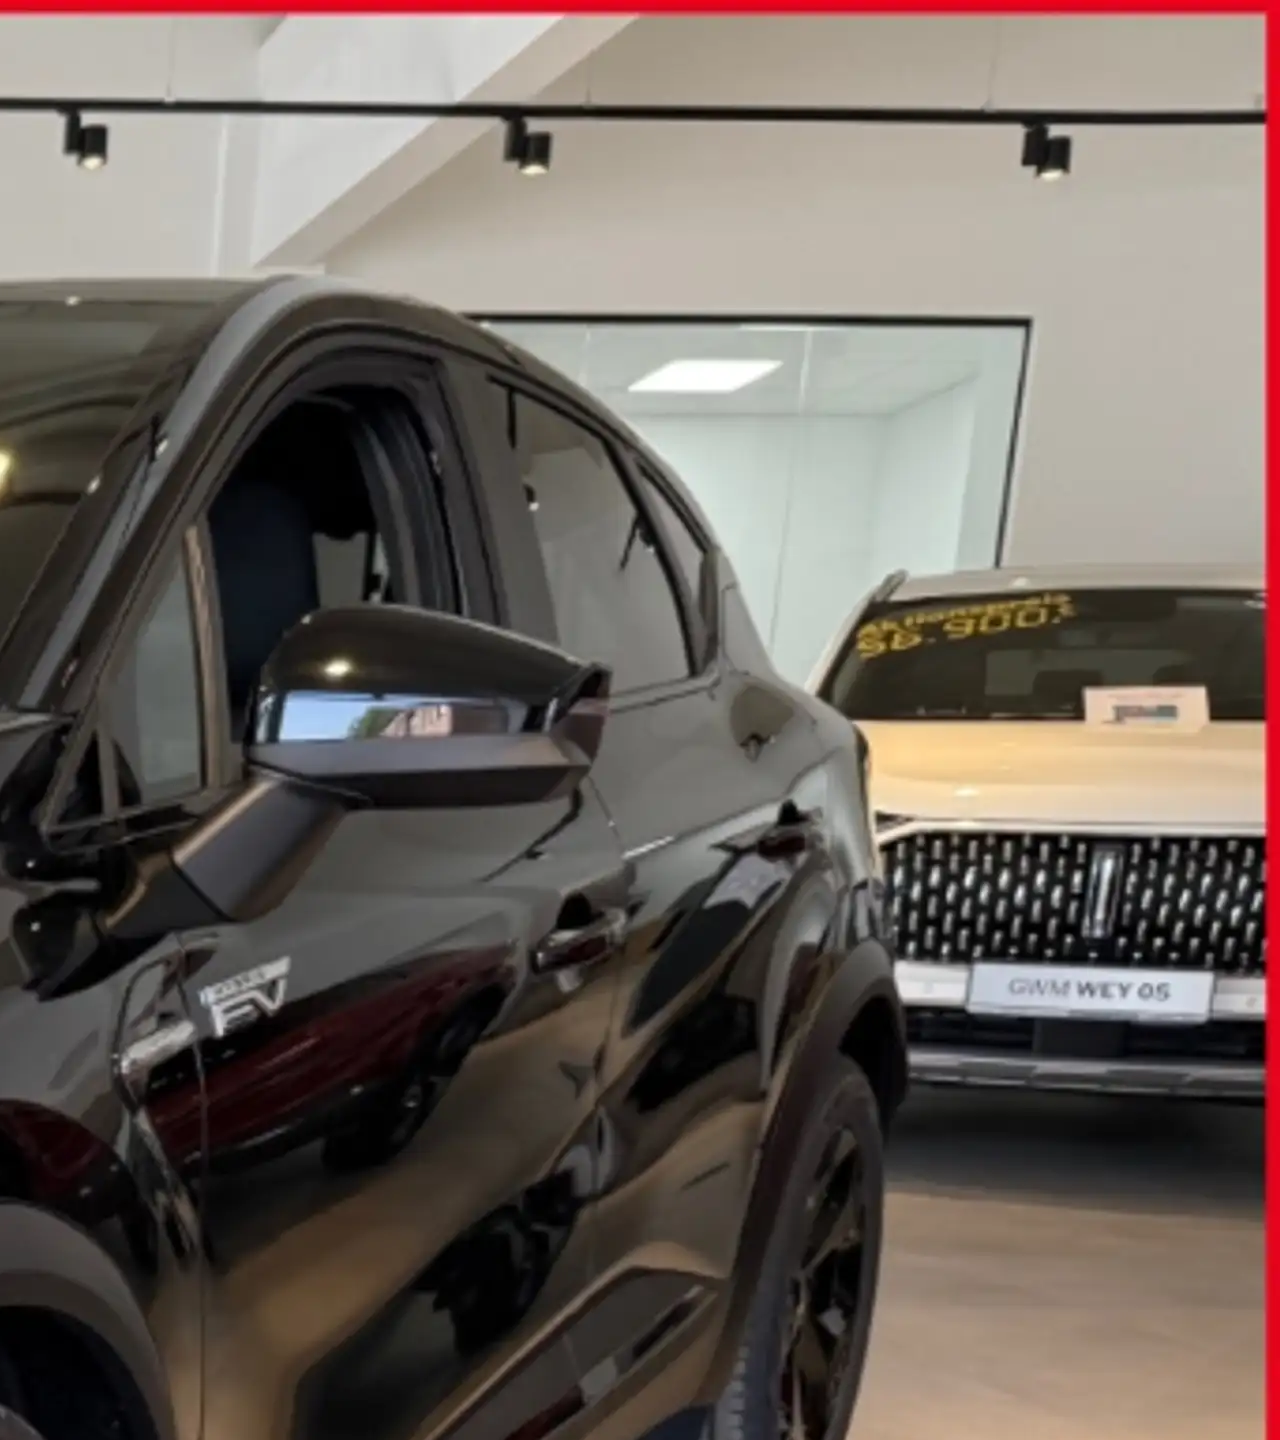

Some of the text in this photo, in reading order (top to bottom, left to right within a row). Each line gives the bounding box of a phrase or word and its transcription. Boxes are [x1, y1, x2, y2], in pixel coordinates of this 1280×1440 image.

[1008, 978, 1172, 1001] GWM WEY 05
